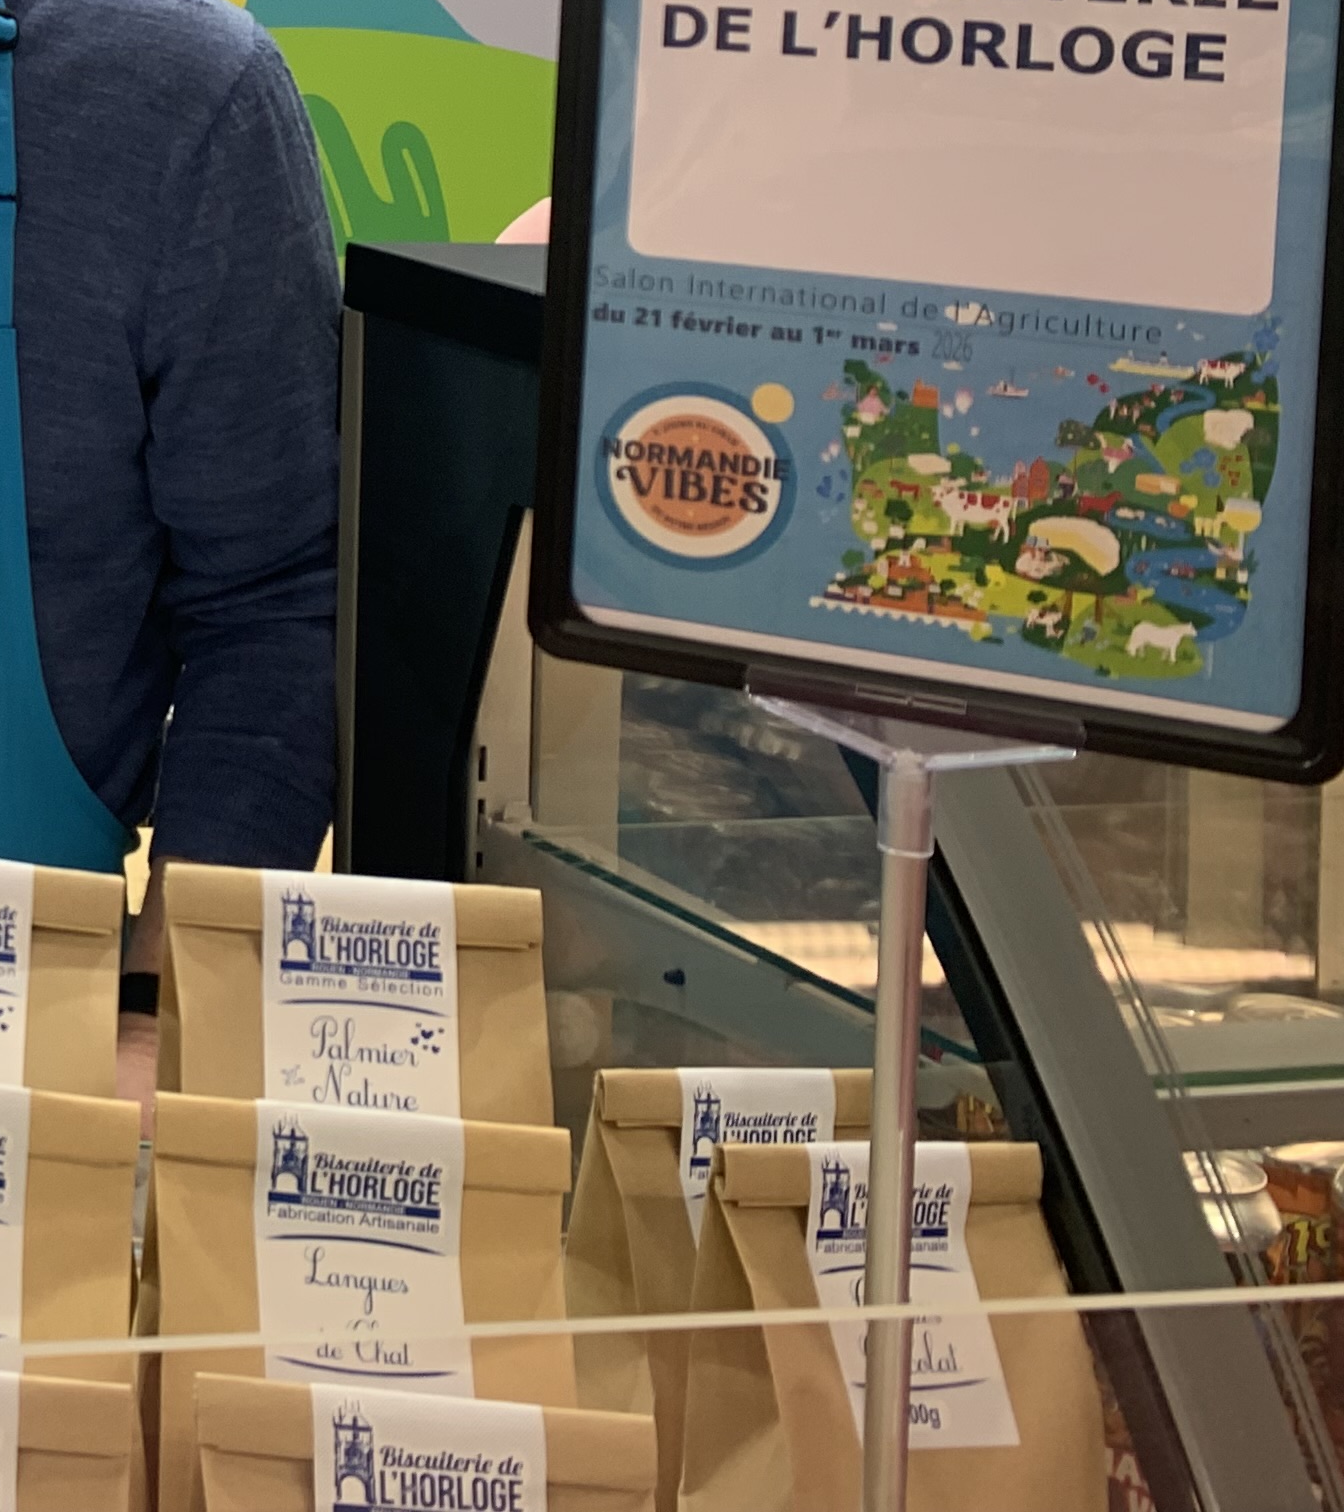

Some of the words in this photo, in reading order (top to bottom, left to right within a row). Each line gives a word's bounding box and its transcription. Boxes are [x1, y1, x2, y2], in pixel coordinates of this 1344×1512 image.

[662, 4, 753, 53] DE
[781, 11, 1229, 83] L'HORLOGE
[595, 264, 674, 294] Salon
[689, 273, 887, 316] International
[901, 296, 939, 322] de
[953, 299, 1163, 345] l'Agriculture
[593, 303, 625, 324] du
[635, 306, 662, 328] 21
[671, 308, 762, 339] février
[771, 327, 803, 344] au
[851, 334, 921, 357] mars
[602, 435, 792, 482] NORMANDIE
[616, 465, 770, 515] VIBES
[320, 916, 415, 938] Biscuiterie
[419, 921, 441, 939] de
[319, 936, 441, 970] L'HORLOGE
[279, 972, 348, 990] Gamme
[358, 975, 444, 997] Sélection
[310, 1015, 419, 1068] Palmier
[313, 1062, 419, 1111] Nature
[724, 1112, 798, 1127] Biscuiterie
[801, 1112, 818, 1127] de
[313, 1152, 415, 1179] Biscuiterie
[419, 1162, 443, 1180] de
[311, 1170, 441, 1207] L'HORLOGE
[935, 1183, 953, 1199] de
[267, 1203, 355, 1225] Fabrication
[359, 1212, 440, 1234] Artisanale
[850, 1201, 950, 1227] L'OGE
[304, 1246, 410, 1316] Langues
[909, 1404, 941, 1429] 00g
[379, 1446, 493, 1474] Biscuiterie
[498, 1455, 524, 1476] de
[379, 1470, 524, 1512] L'HORLOGE
